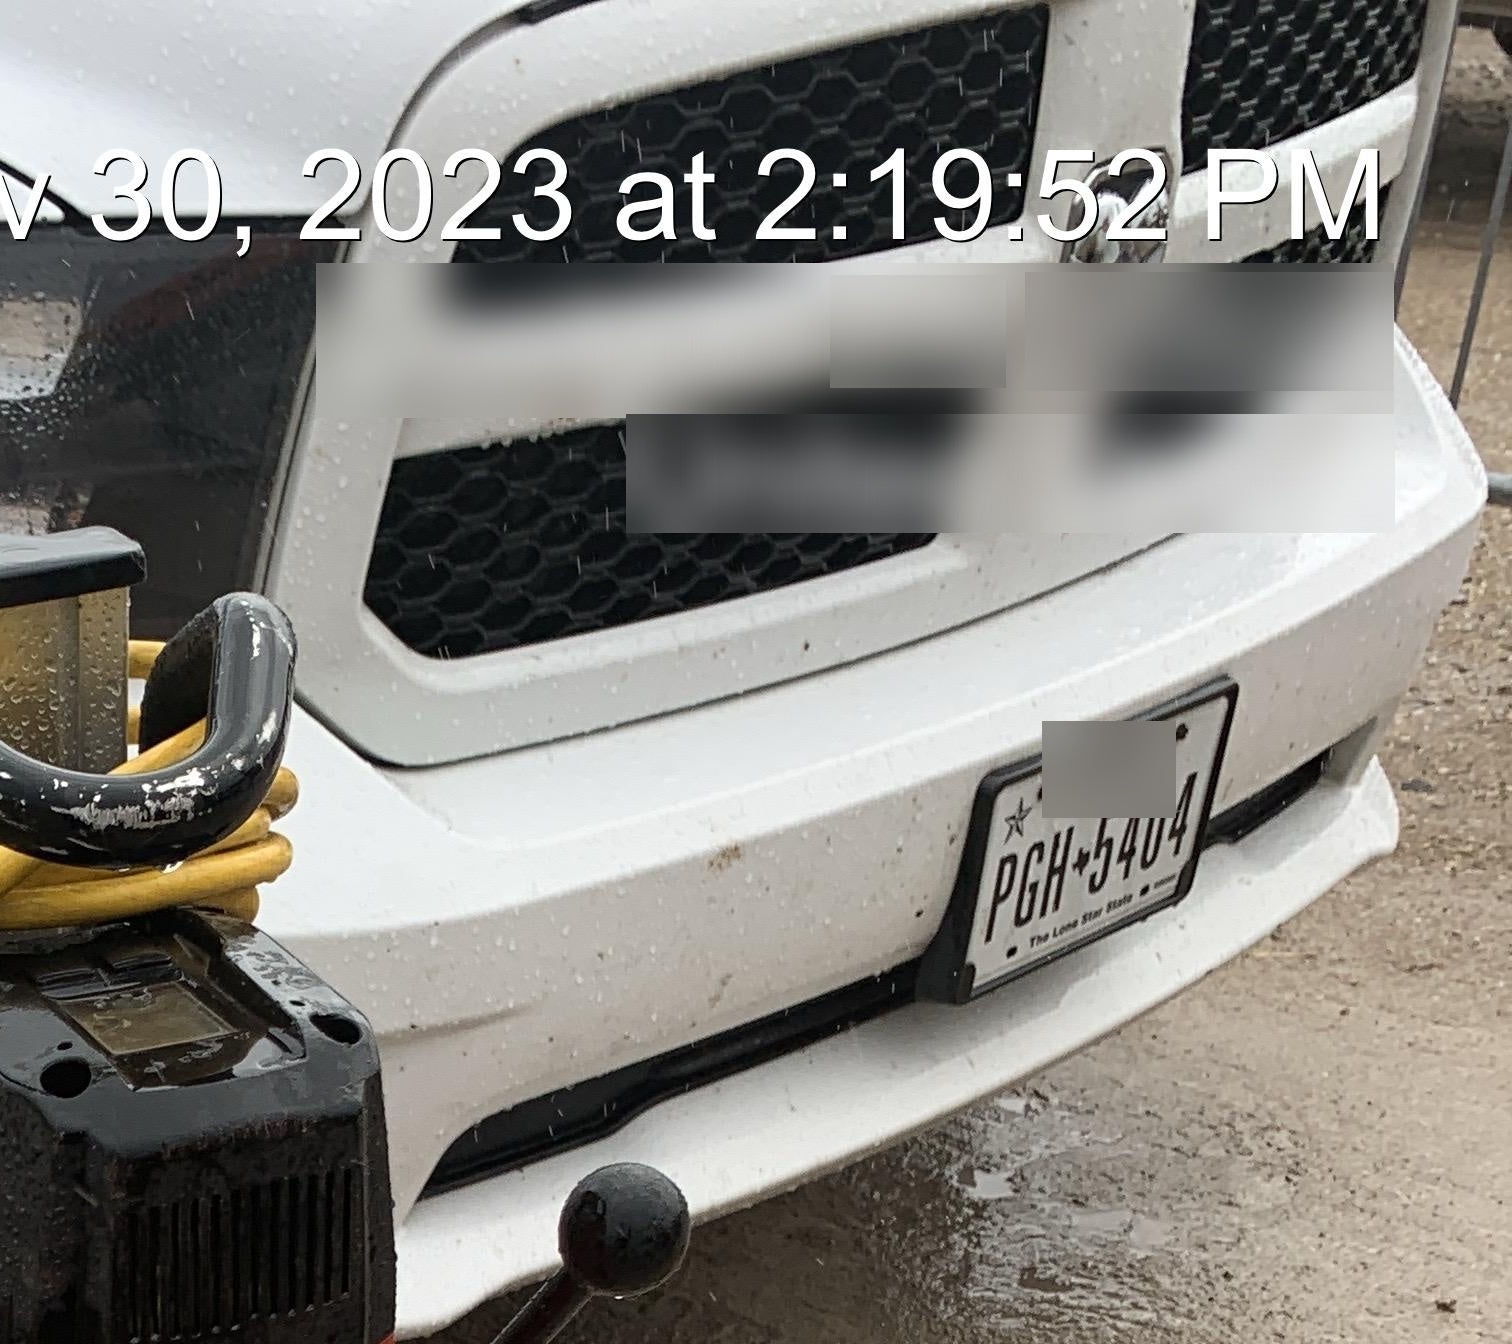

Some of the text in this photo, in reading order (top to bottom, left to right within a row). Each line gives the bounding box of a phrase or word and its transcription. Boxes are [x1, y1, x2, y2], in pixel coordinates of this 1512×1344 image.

[984, 825, 1076, 945] PGH
[1029, 893, 1134, 948] The Lone Star State
